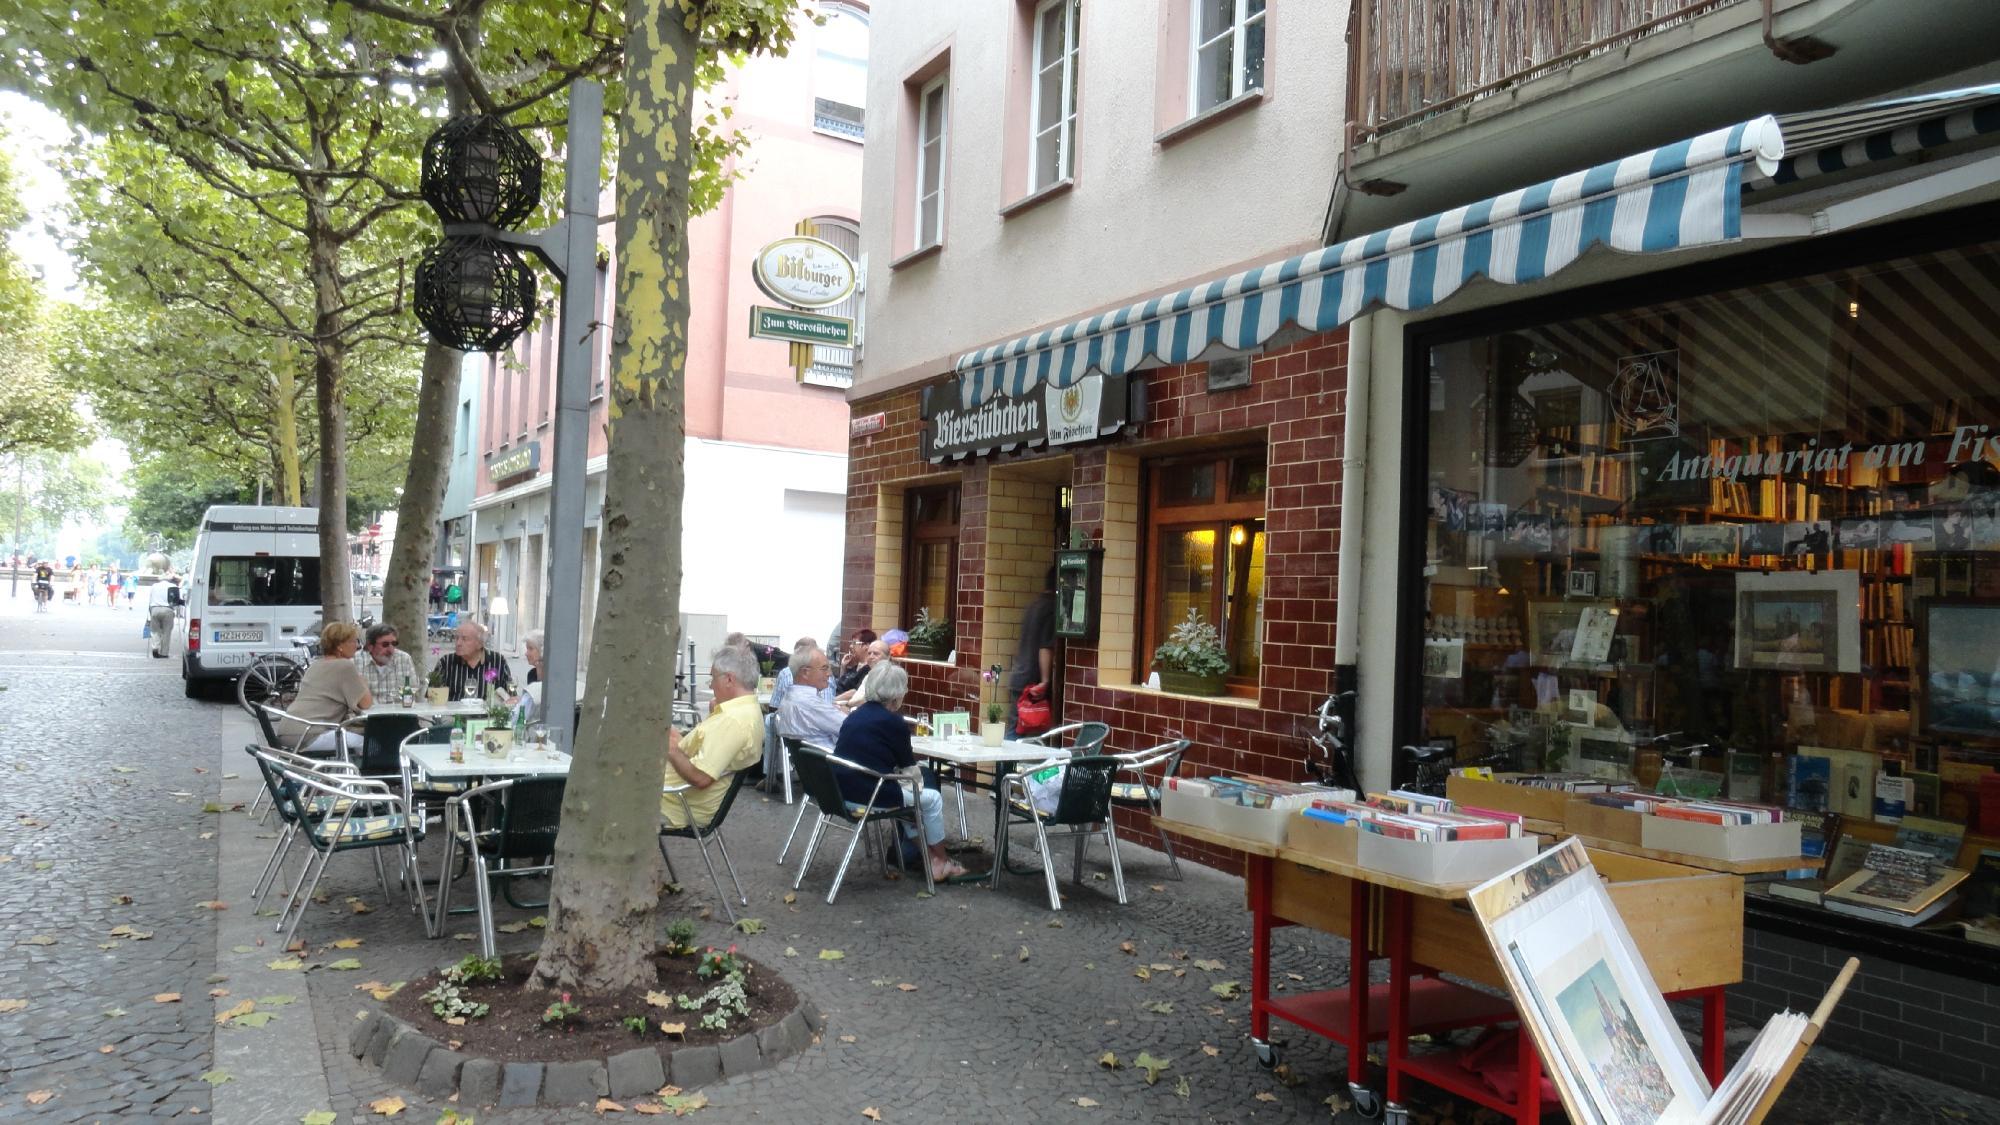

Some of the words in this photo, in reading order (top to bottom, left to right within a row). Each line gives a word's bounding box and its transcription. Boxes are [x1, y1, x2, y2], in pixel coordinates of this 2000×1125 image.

[776, 254, 843, 288] Bitburger
[763, 316, 785, 329] Zum
[787, 319, 847, 336] Bierstübchen
[933, 389, 1040, 450] Bierstübchen
[1656, 438, 1853, 484] Antiquariat
[1863, 440, 1926, 468] am
